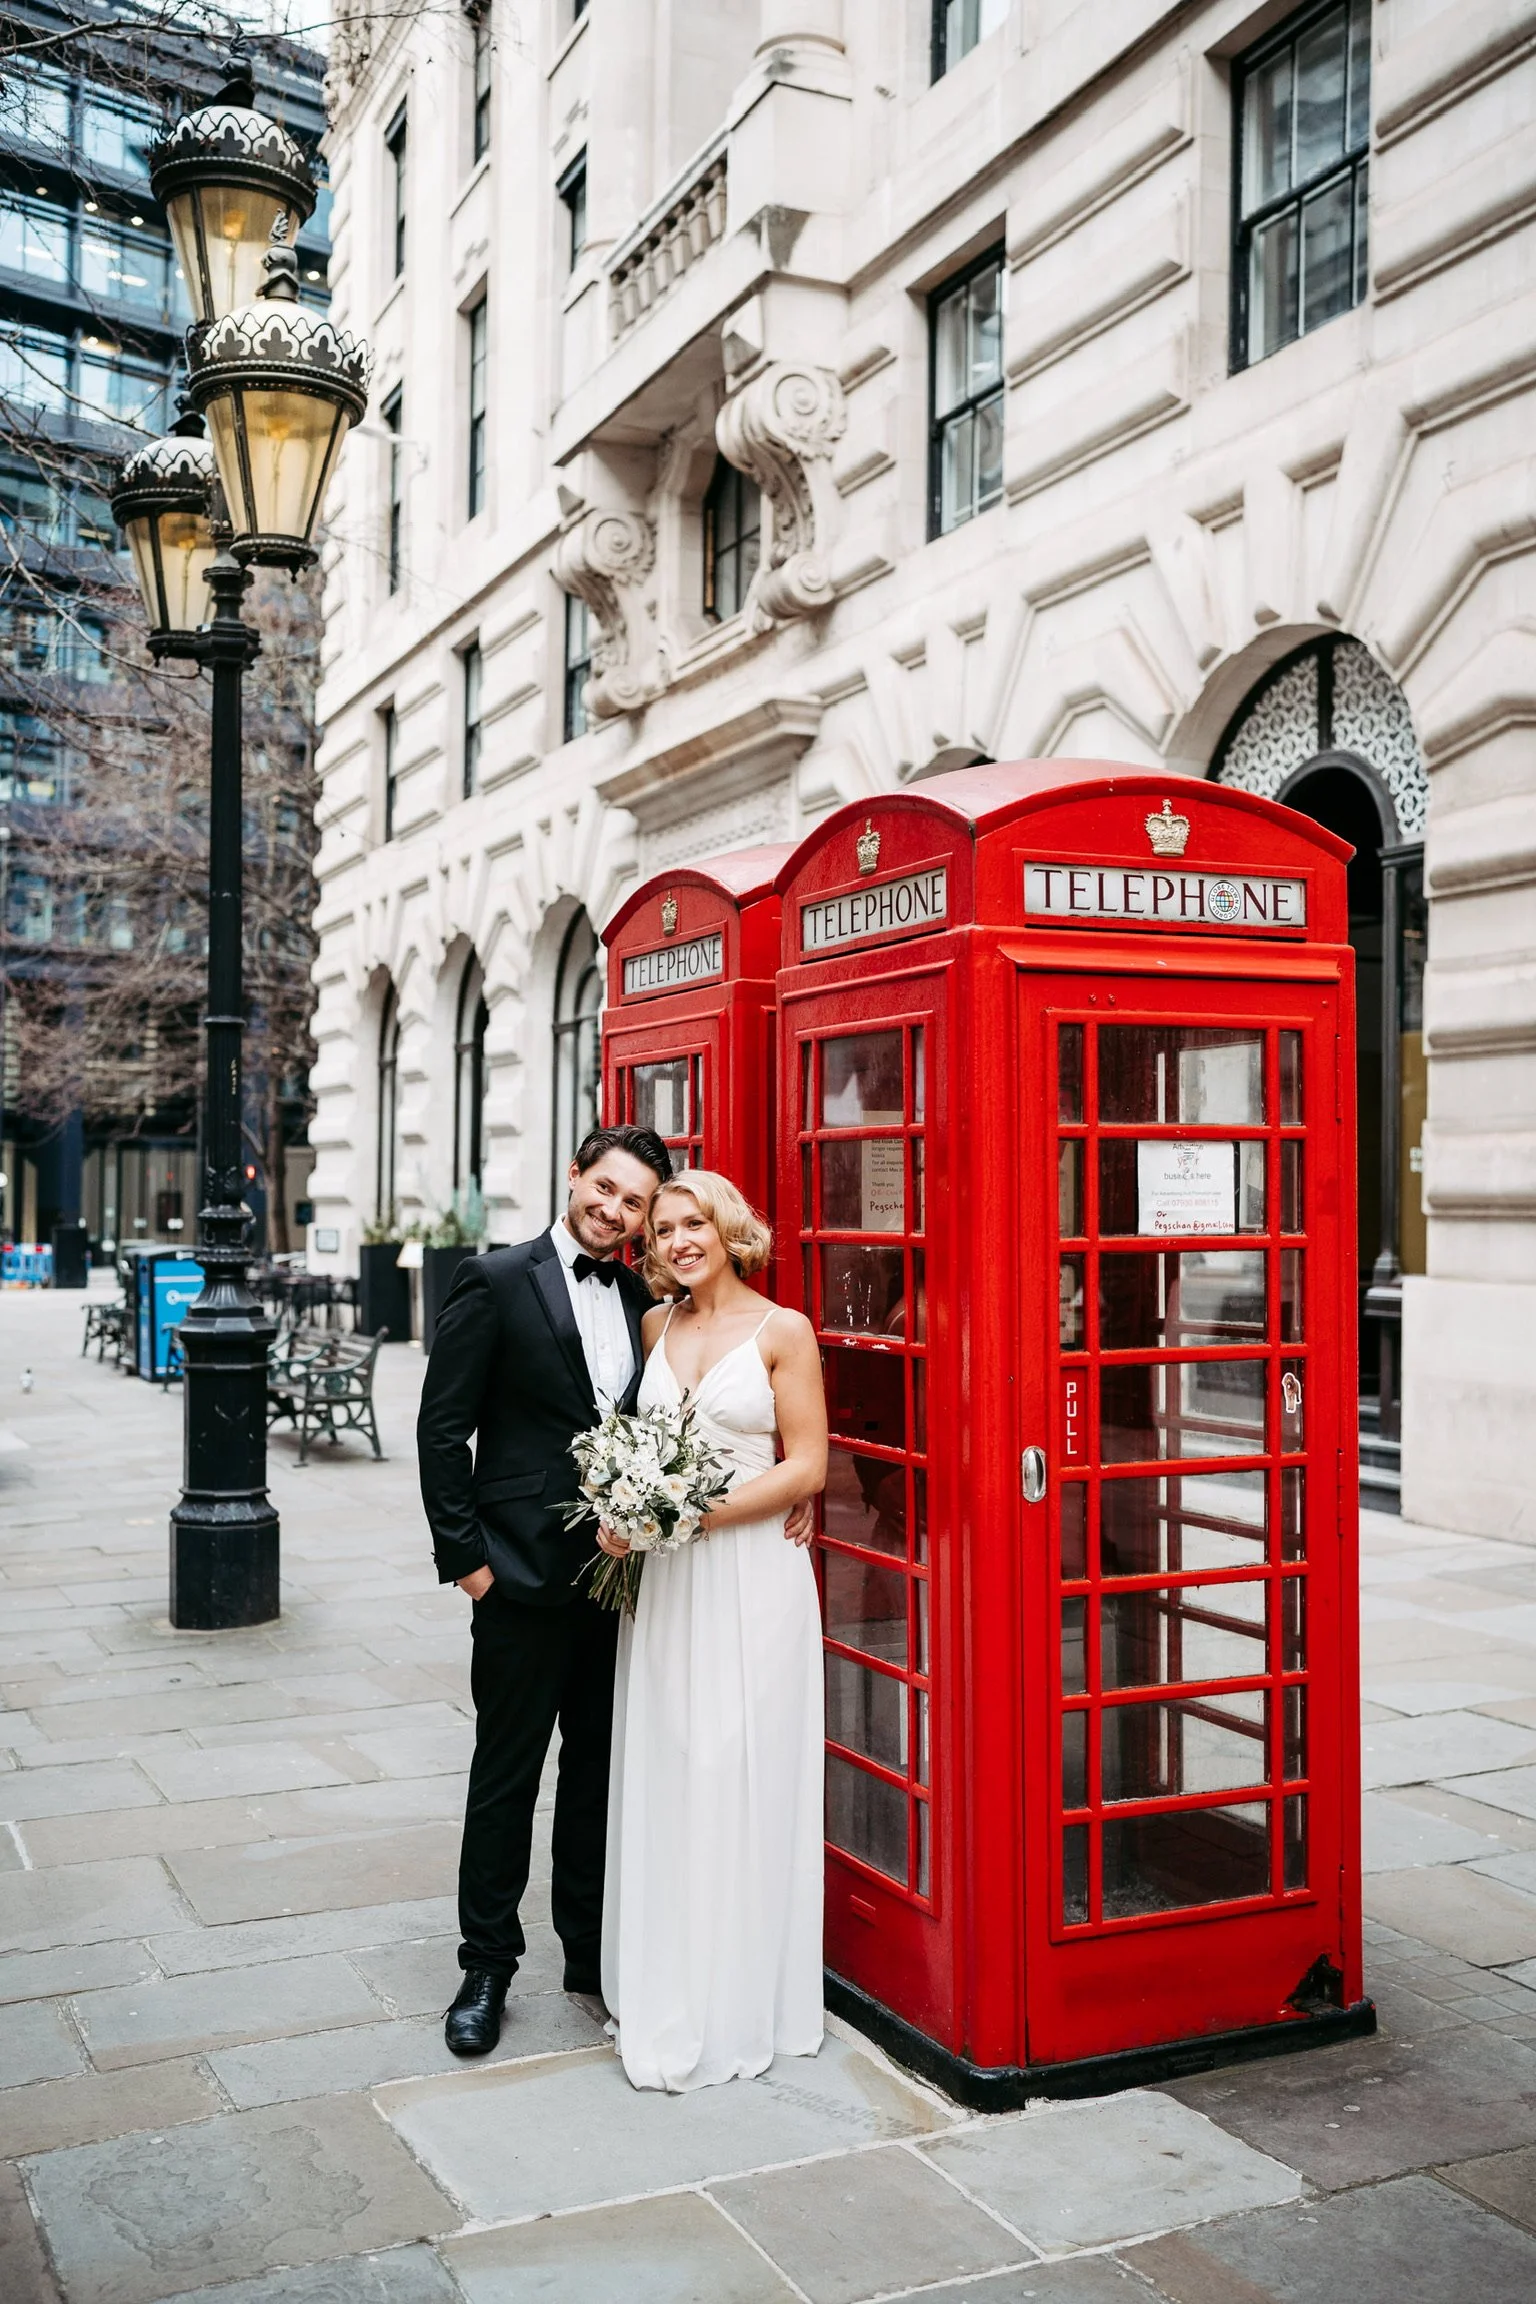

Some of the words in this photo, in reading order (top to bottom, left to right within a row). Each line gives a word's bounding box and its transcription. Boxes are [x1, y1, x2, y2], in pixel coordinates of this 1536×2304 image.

[808, 870, 945, 944] TELEPHONE
[1032, 868, 1293, 921] TELEPHNE
[628, 937, 721, 990] TELEPHONE
[1066, 1381, 1078, 1455] PULL
